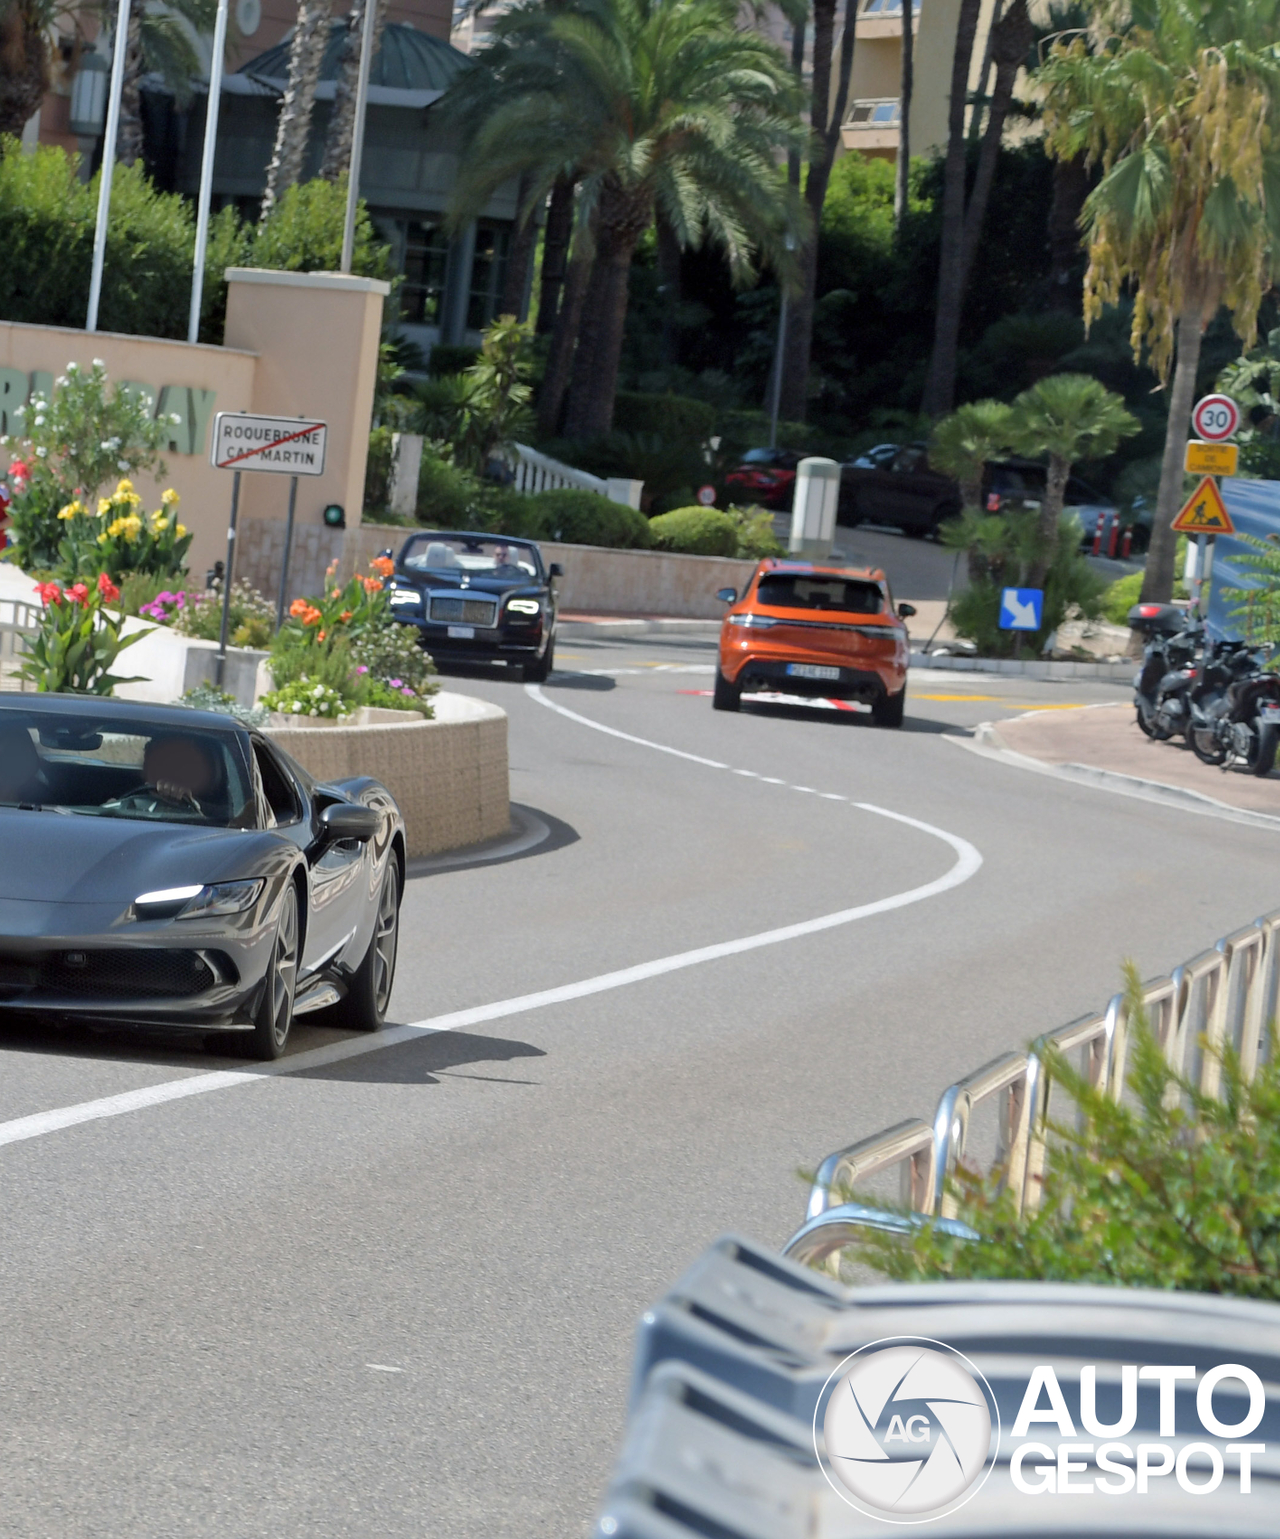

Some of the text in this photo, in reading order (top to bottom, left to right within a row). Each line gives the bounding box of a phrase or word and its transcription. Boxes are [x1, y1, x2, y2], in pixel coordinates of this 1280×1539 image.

[1204, 410, 1228, 428] 30
[223, 425, 320, 446] ROQUEBRUNE
[226, 446, 315, 465] CAP-MARTIN
